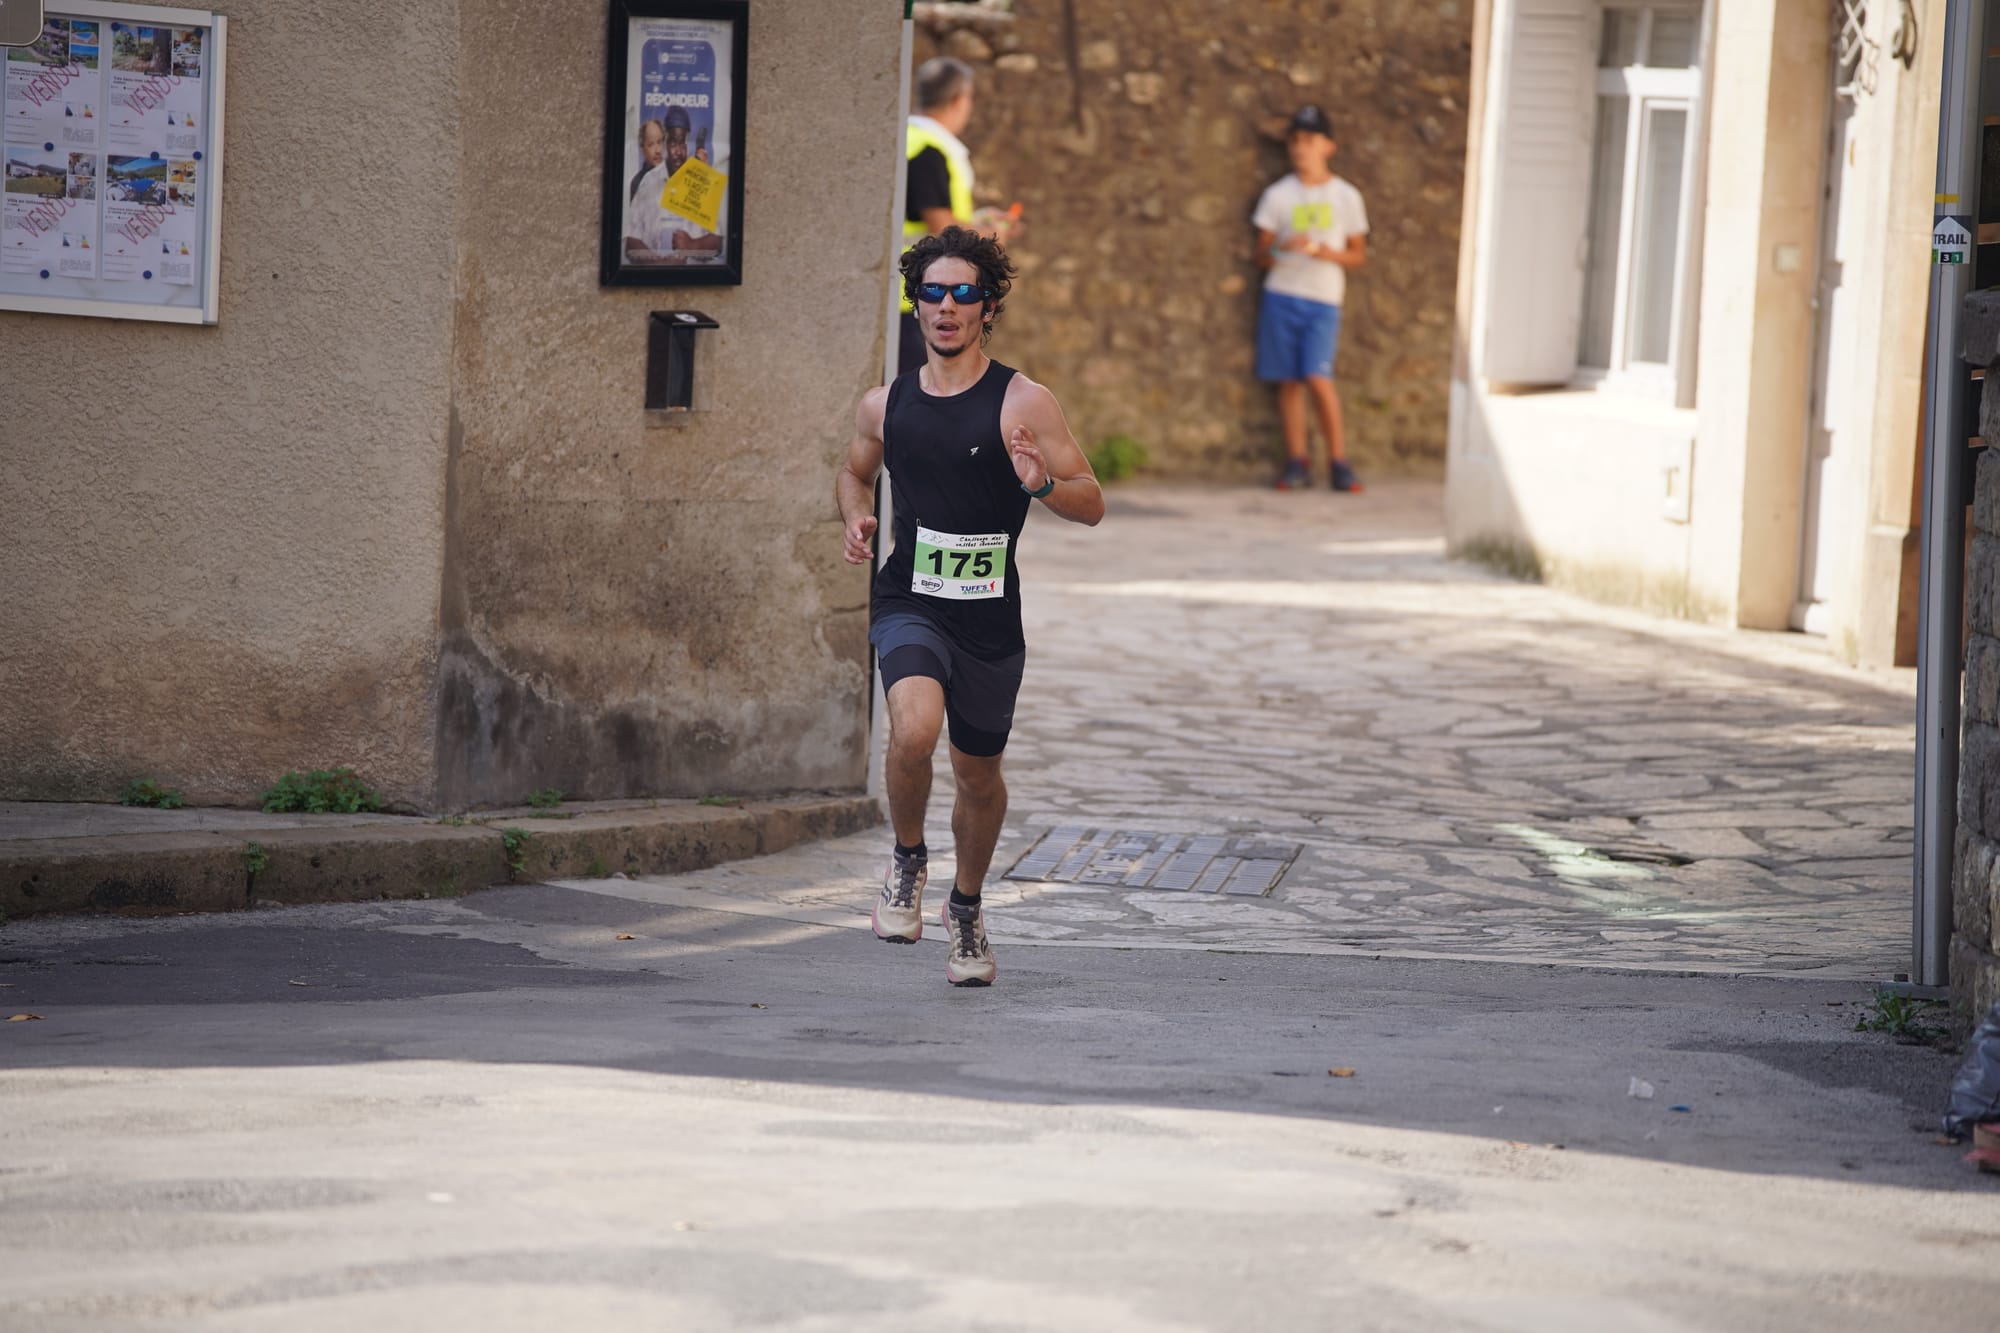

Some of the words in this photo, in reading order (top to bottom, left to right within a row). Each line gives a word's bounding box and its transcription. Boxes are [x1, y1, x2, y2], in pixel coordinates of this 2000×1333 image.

[21, 58, 81, 107] VENDU
[123, 72, 182, 117] VENDU
[17, 191, 77, 238] VENDU
[118, 199, 177, 245] VENDU
[1934, 233, 1967, 245] TRAIL
[928, 550, 993, 578] 175
